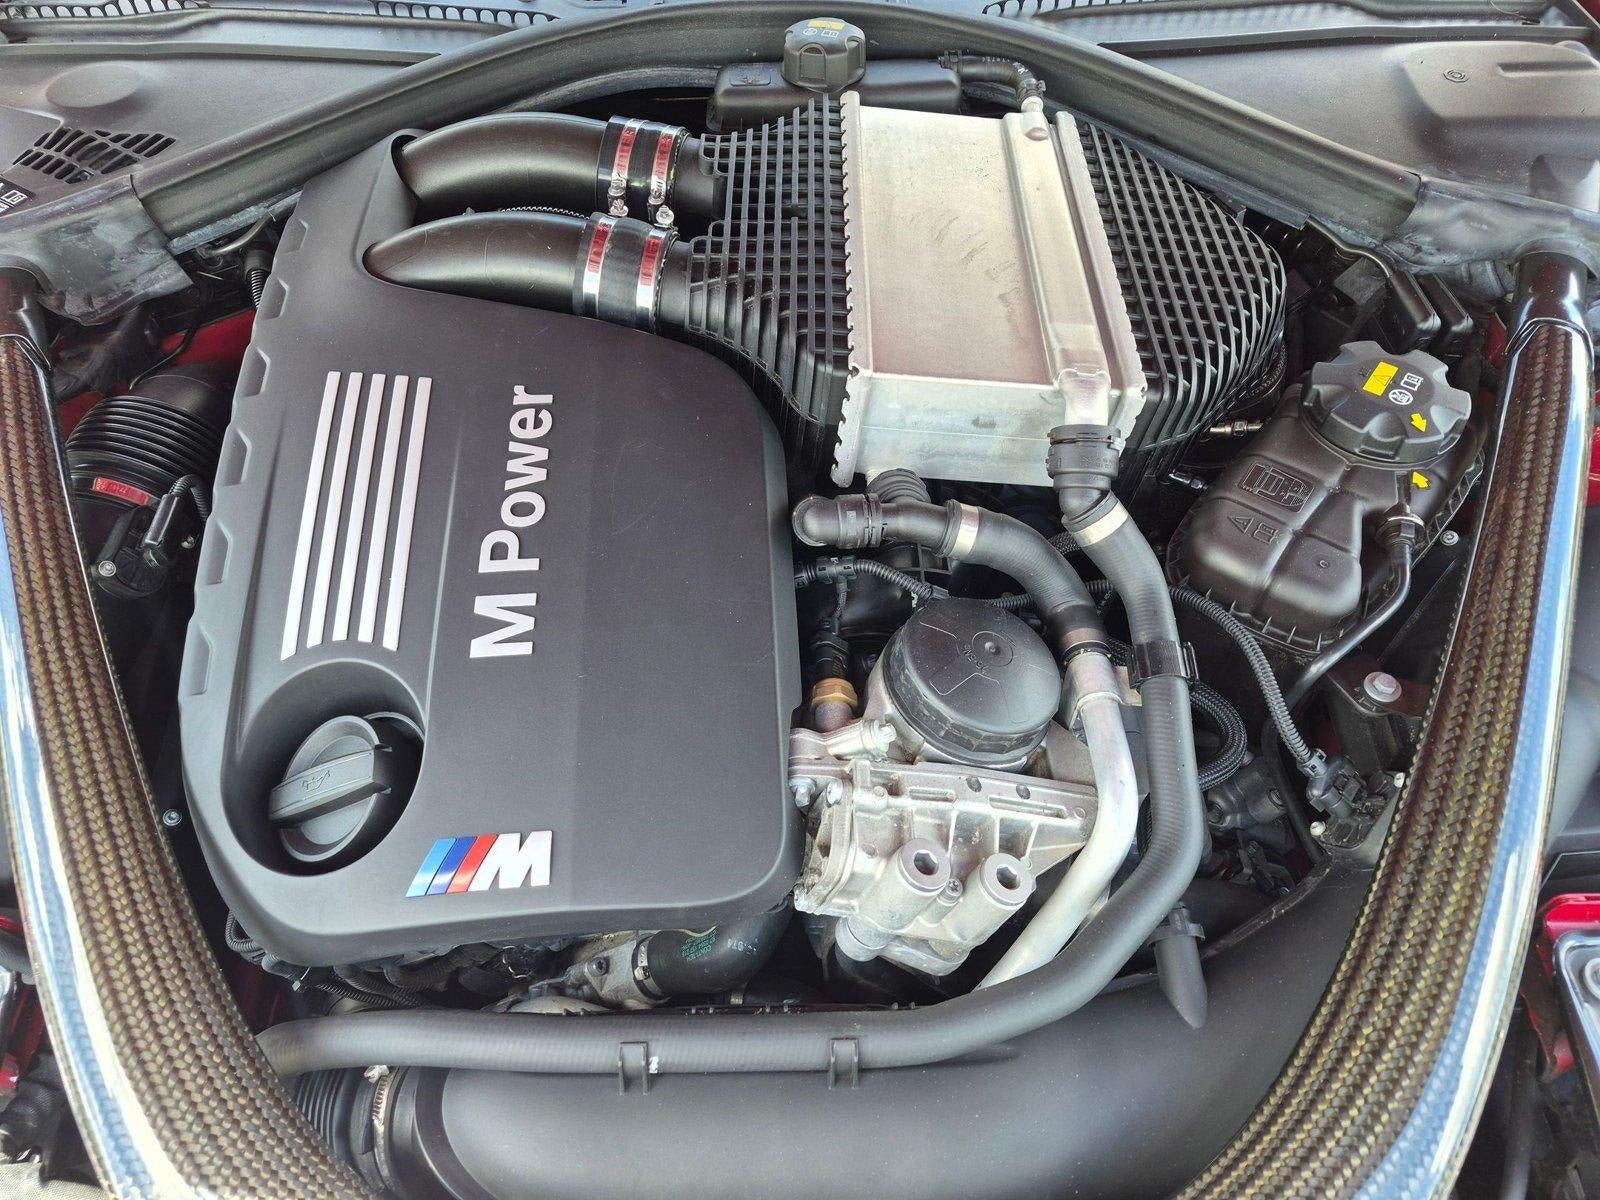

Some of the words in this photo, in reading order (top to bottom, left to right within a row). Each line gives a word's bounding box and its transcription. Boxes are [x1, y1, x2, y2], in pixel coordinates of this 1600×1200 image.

[478, 385, 554, 573] Power
[469, 593, 537, 658] M
[468, 830, 553, 892] M
